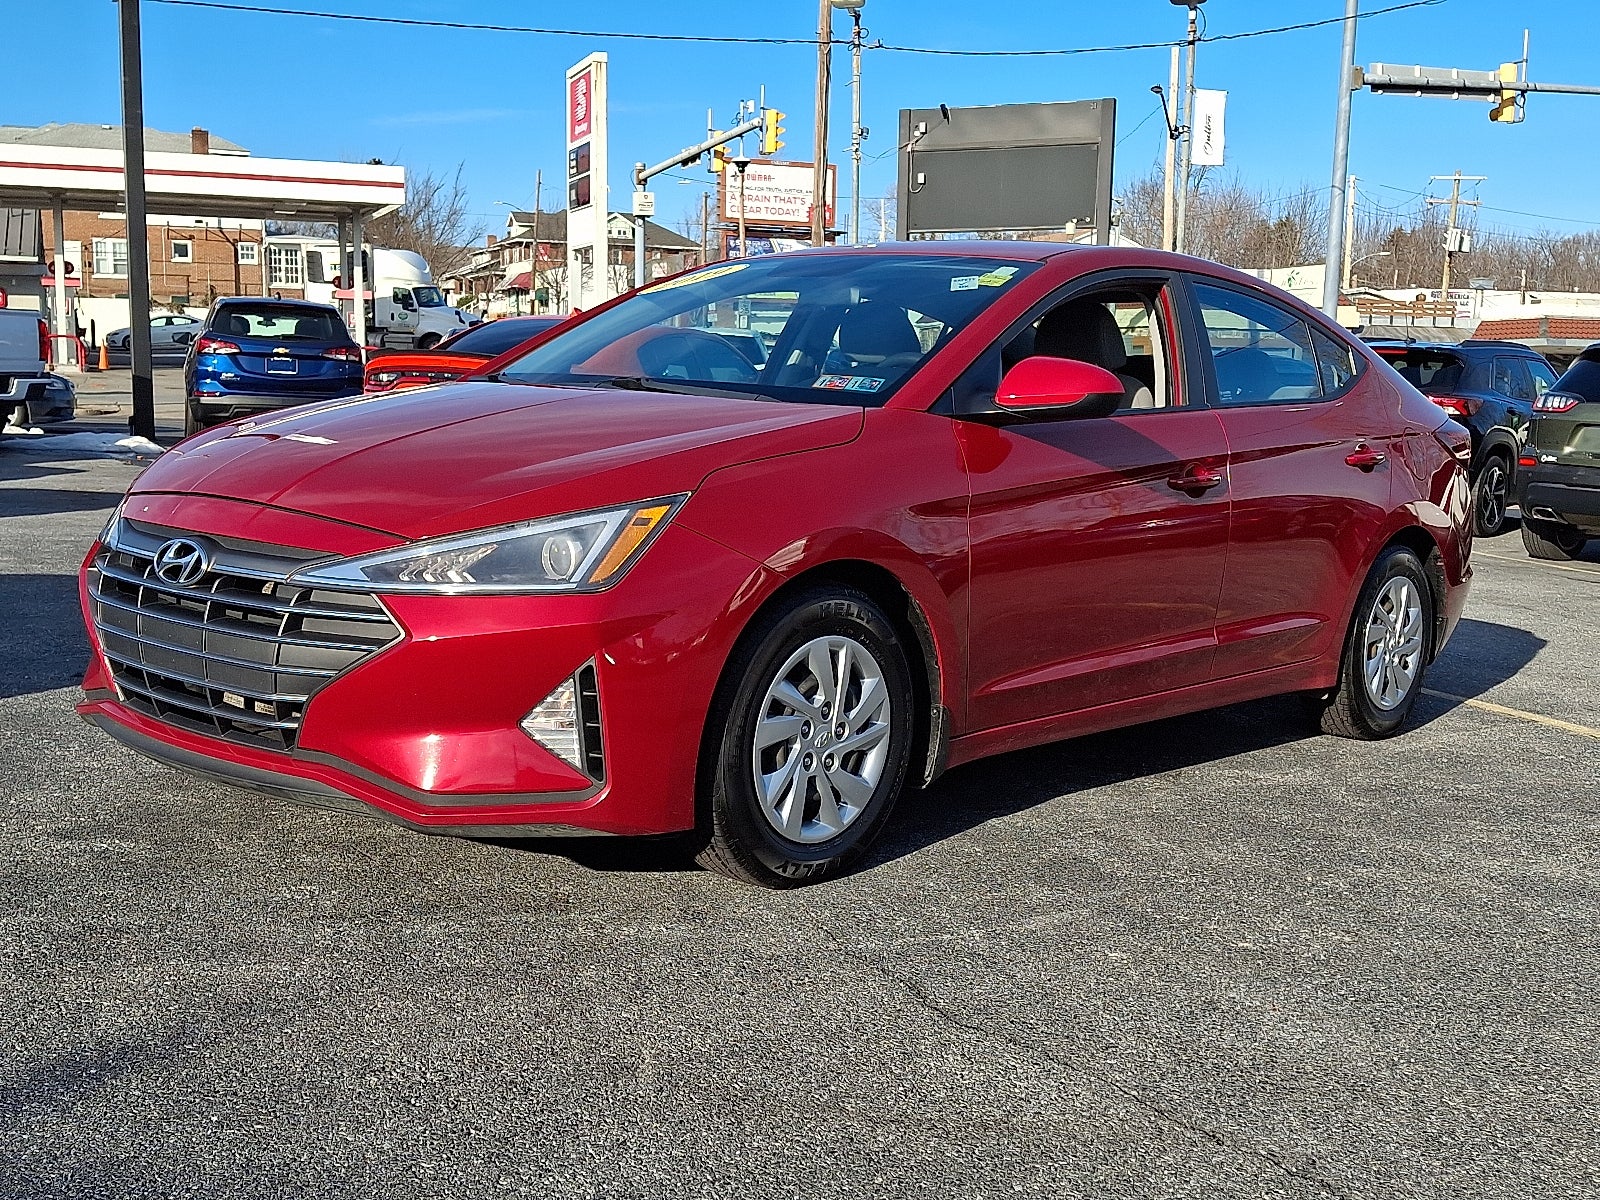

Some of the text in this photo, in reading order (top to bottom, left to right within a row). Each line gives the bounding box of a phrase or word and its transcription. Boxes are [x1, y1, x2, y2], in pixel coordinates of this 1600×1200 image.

[730, 193, 737, 201] A
[773, 195, 806, 206] THAT'S
[764, 206, 800, 217] TODAY!
[818, 600, 874, 625] KELLY
